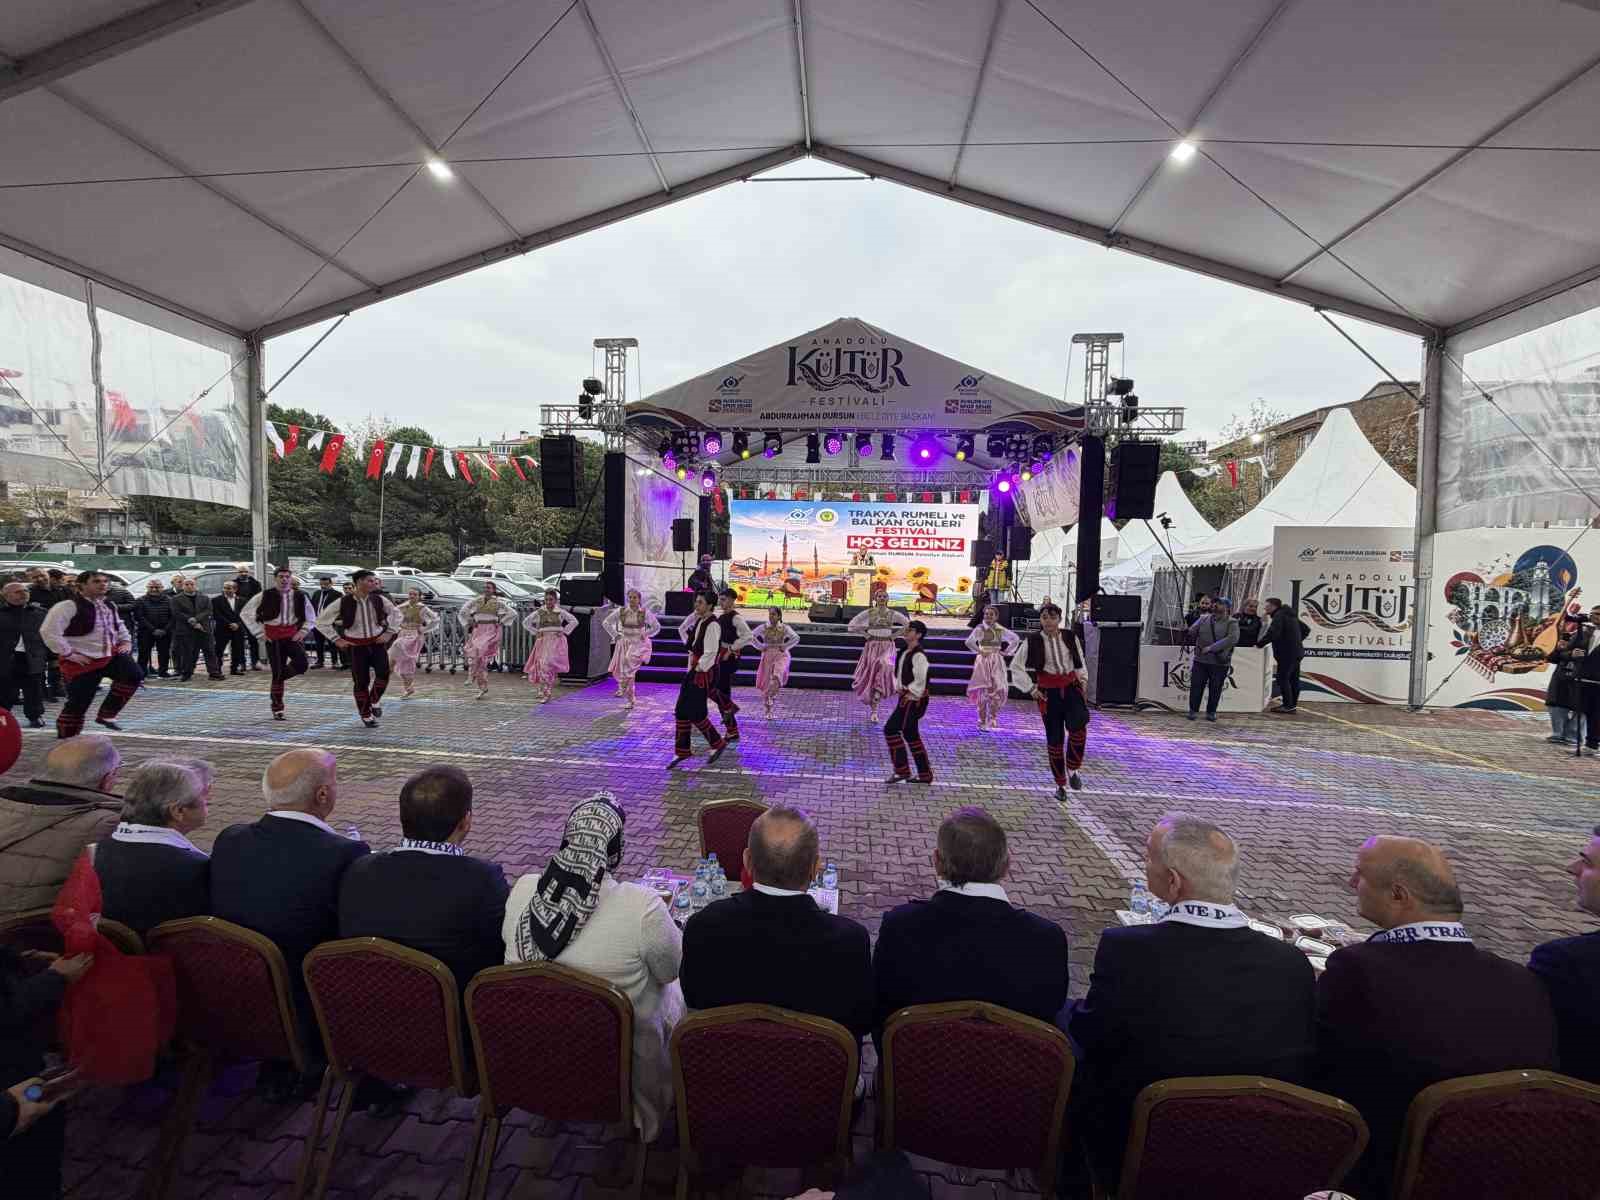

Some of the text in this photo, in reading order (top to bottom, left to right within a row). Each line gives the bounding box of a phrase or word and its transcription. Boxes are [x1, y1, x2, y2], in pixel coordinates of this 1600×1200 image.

[811, 337, 888, 345] ANADOLU
[785, 346, 912, 387] KÜLTÜR
[809, 395, 886, 406] FESTİVALİ
[760, 411, 820, 420] ABDURRAHMAN
[822, 411, 855, 420] DURSUN
[848, 510, 898, 519] TRAKYA
[951, 512, 966, 520] ve
[851, 518, 903, 527] BALKAN
[849, 536, 963, 550] HOŞ GELDİNİZ
[1319, 573, 1407, 582] ANADOLU
[1184, 904, 1209, 917] VE
